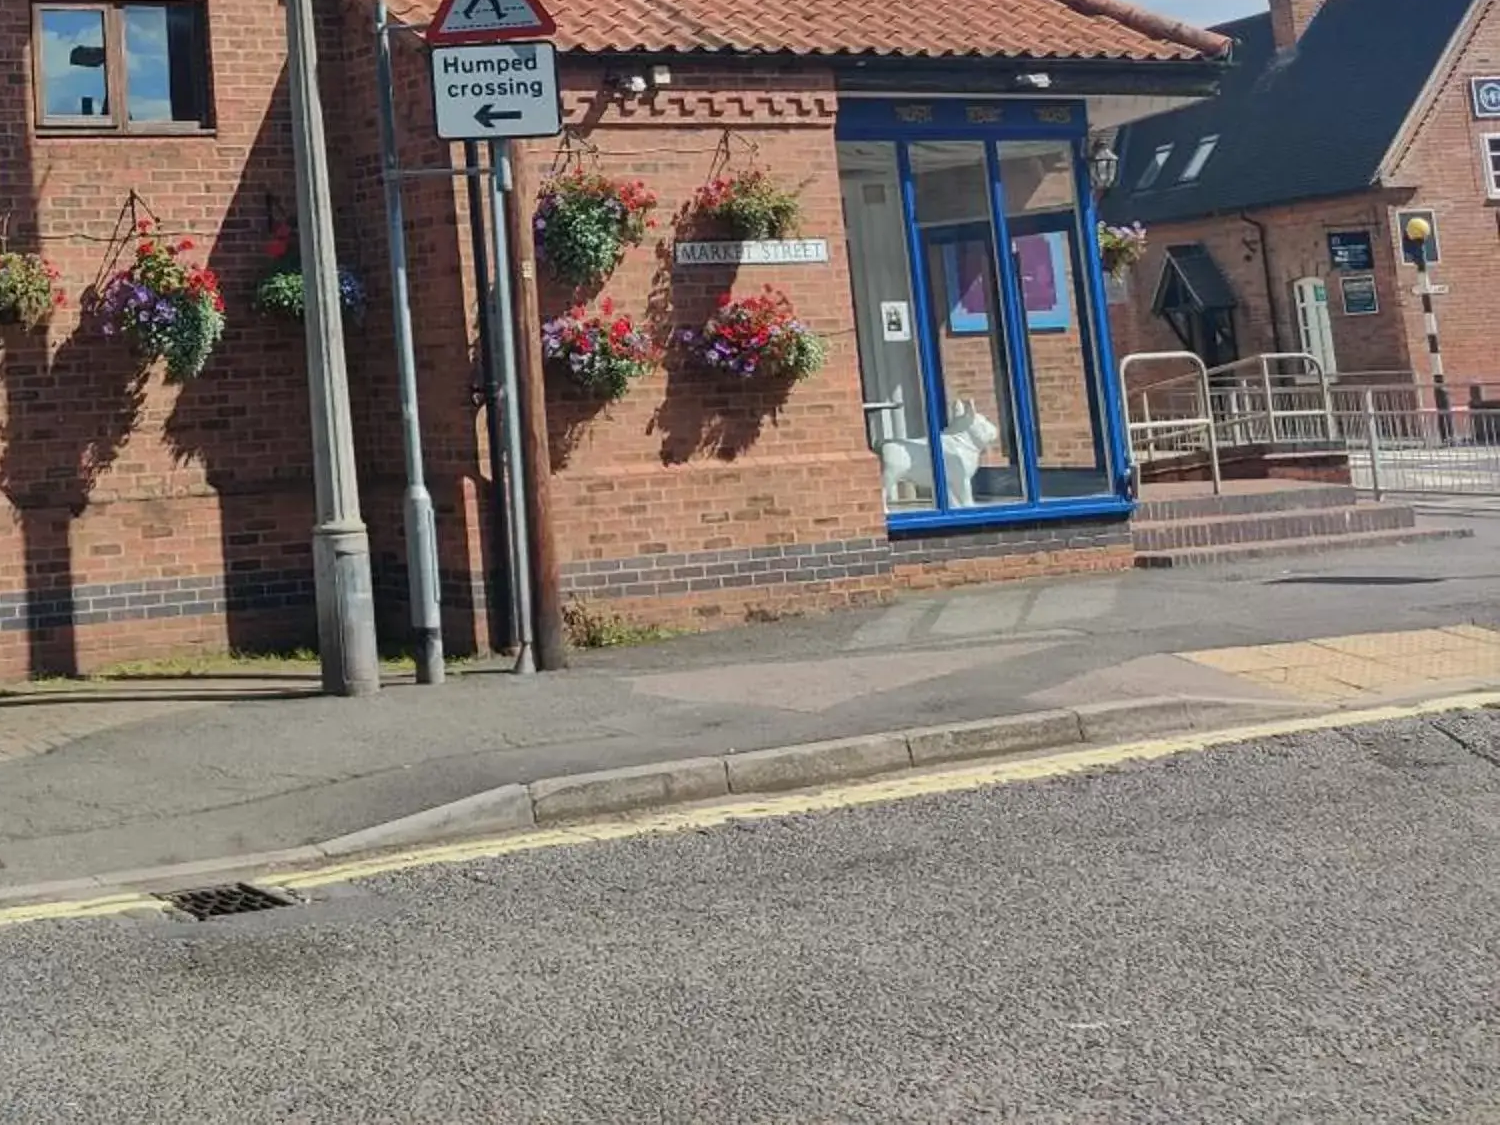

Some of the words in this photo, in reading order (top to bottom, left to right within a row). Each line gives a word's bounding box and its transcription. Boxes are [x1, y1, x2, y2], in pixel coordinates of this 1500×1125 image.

[443, 55, 537, 76] Humped
[447, 78, 543, 98] crossing
[681, 244, 753, 261] MARKET
[760, 242, 821, 261] STREET
